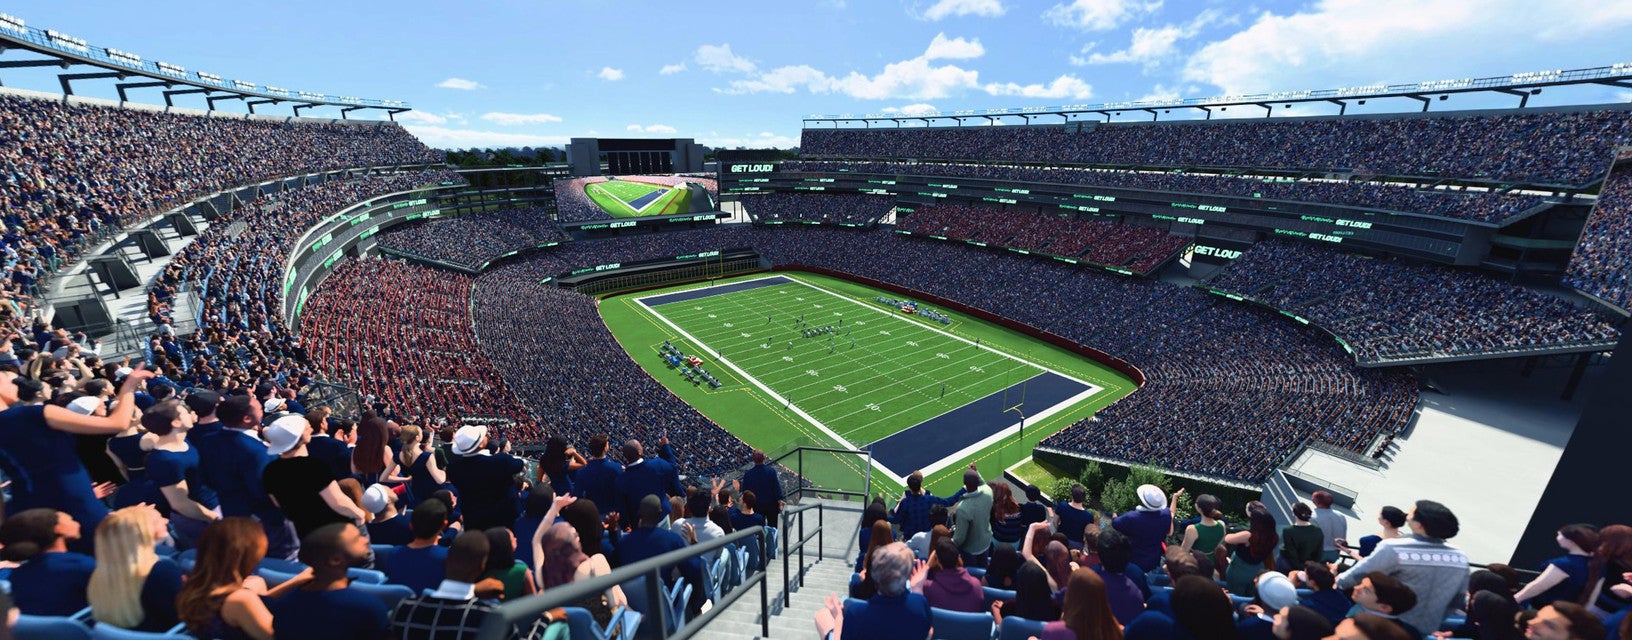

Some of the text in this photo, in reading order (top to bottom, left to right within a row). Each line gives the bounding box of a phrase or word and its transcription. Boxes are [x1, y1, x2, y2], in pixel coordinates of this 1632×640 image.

[748, 164, 774, 172] LOUD!
[1194, 245, 1215, 256] GET
[864, 402, 880, 411] 10
